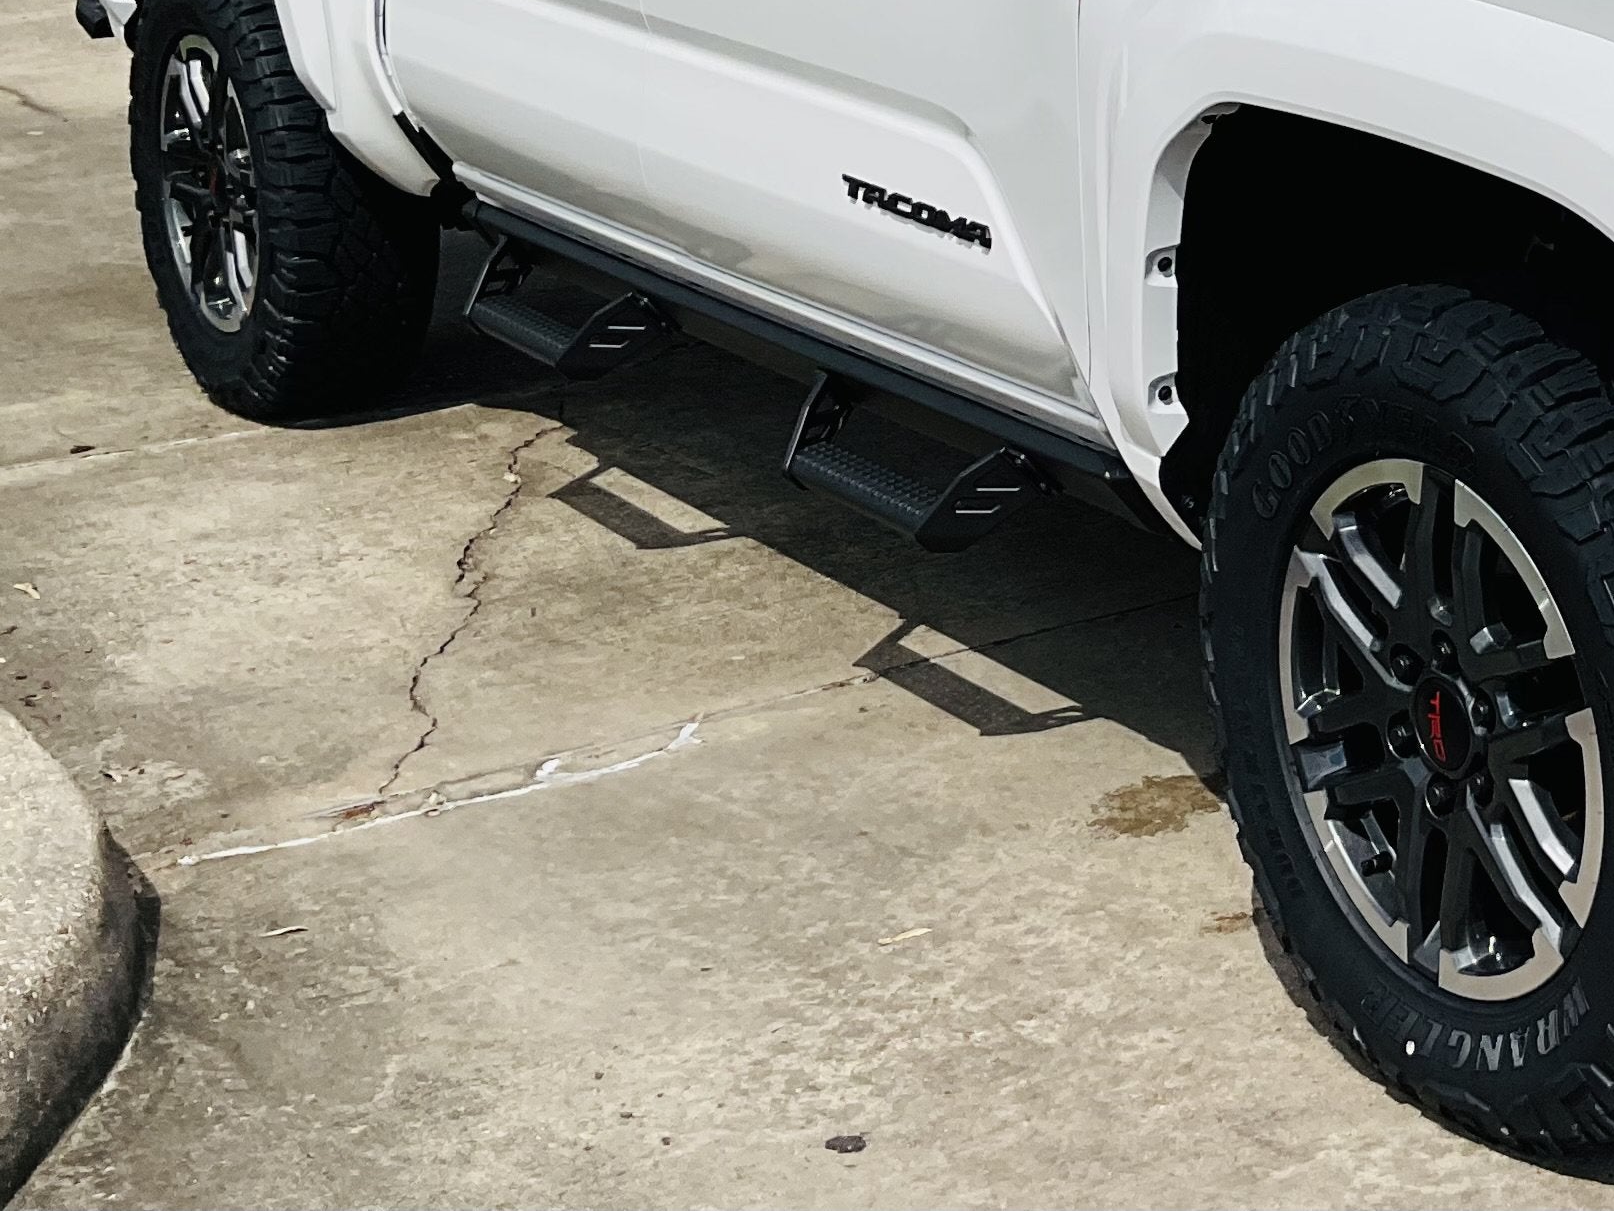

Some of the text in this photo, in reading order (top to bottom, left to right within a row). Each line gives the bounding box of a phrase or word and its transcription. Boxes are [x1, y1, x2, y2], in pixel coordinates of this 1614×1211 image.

[841, 173, 993, 250] TACOMA
[1427, 690, 1447, 763] TRD
[1360, 976, 1590, 1072] WRANGLER
